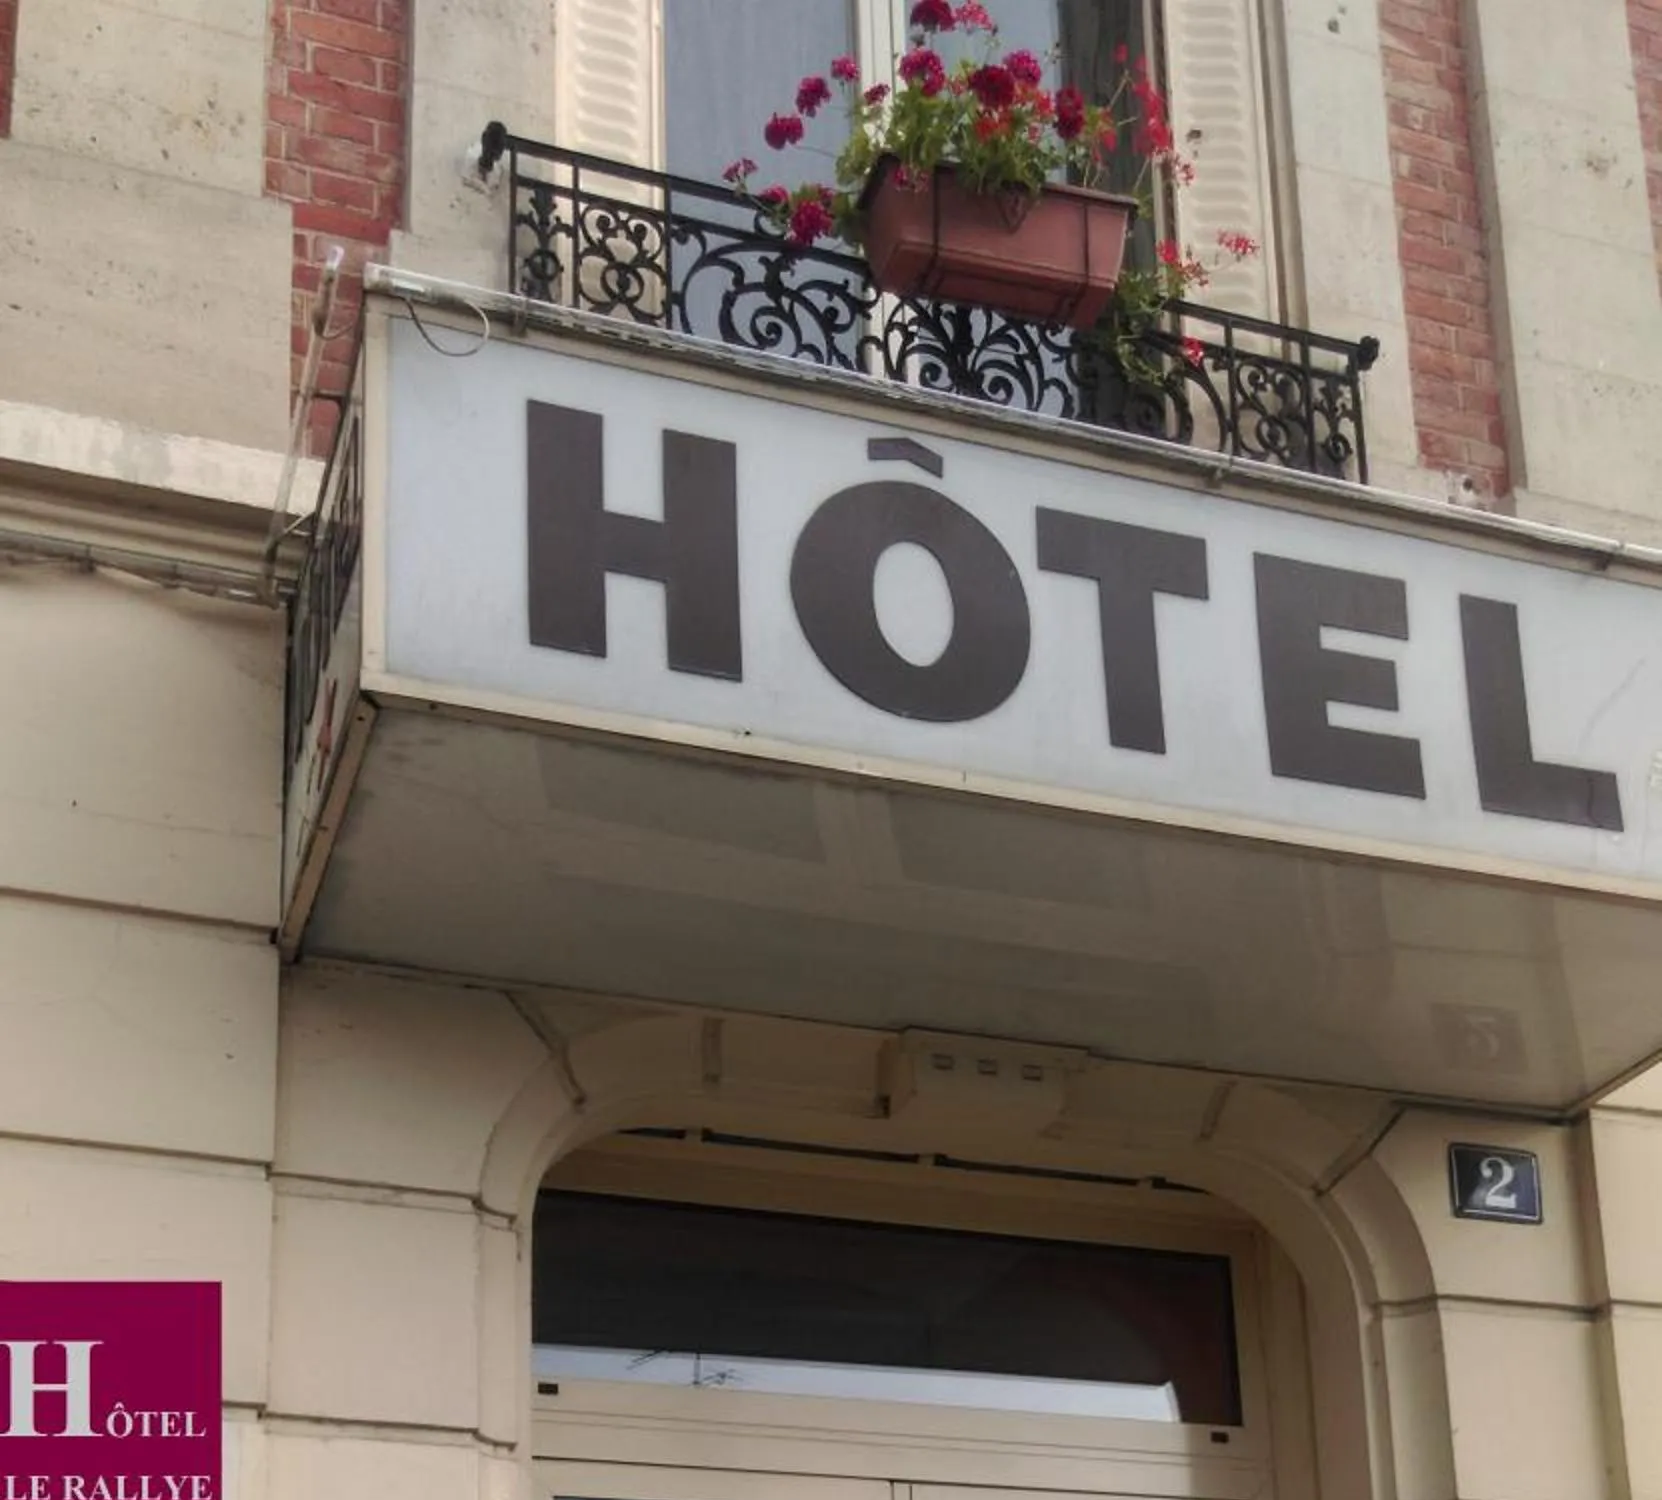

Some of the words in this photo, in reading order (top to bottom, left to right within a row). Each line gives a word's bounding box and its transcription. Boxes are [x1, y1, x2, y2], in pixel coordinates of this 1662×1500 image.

[527, 399, 1624, 832] HÔTEL
[1480, 1156, 1517, 1209] 2
[0, 1339, 206, 1439] HÔTEL
[4, 1474, 51, 1500] LE
[62, 1474, 213, 1500] RALLYE
